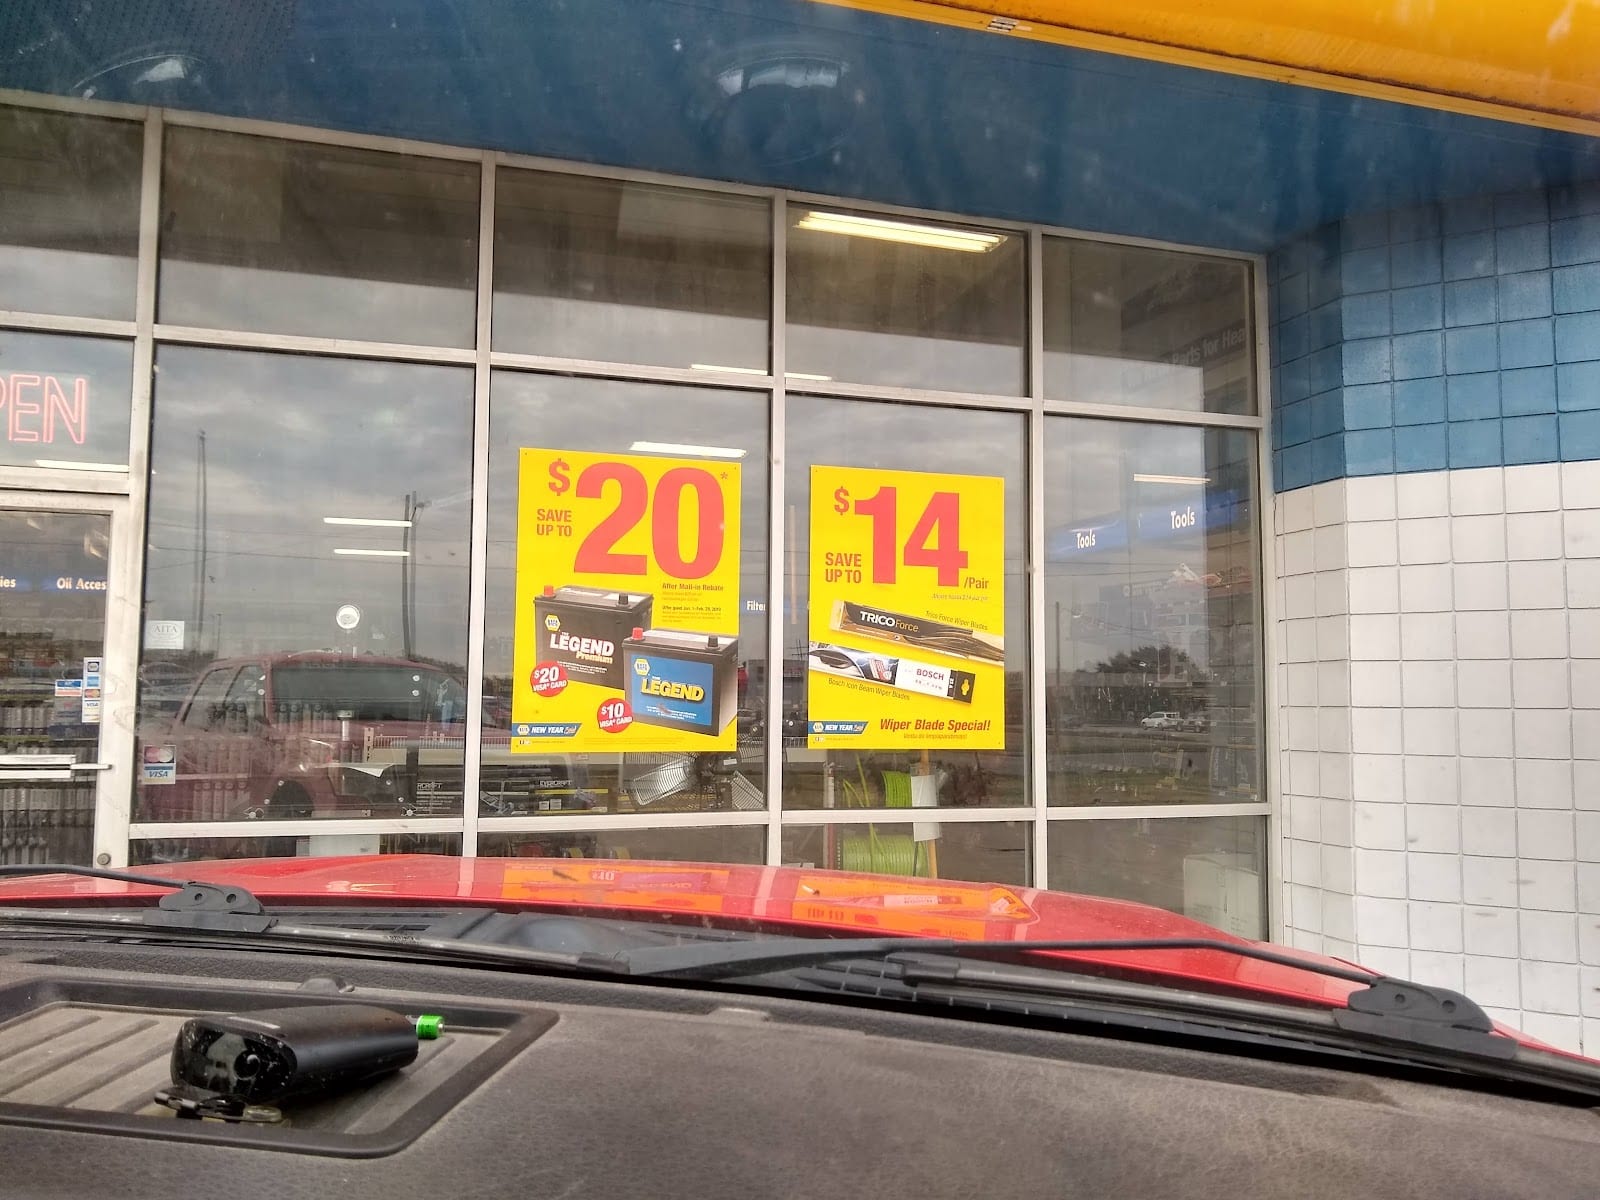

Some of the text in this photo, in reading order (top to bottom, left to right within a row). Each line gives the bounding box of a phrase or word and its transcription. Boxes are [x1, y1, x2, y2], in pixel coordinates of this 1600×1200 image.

[0, 373, 87, 444] EN
[536, 508, 572, 523] SAVE
[1171, 506, 1195, 529] Tools
[536, 523, 572, 537] UP TO
[834, 486, 968, 587] $14
[1077, 530, 1096, 549] Tools
[825, 552, 862, 567] SAVE
[56, 577, 72, 589] Oil
[825, 569, 862, 584] UP TO
[963, 577, 990, 589] /Pair
[860, 611, 896, 627] TRICO
[895, 620, 919, 633] Force
[550, 633, 615, 657] LEGEND
[576, 651, 613, 665] Premium
[534, 666, 560, 684] $20
[916, 668, 944, 681] BOSCH
[550, 680, 567, 689] CARD
[641, 678, 705, 702] LEGEND
[828, 678, 845, 687] Bosch
[859, 684, 875, 693] Beam
[875, 688, 891, 697] Wiper
[891, 691, 910, 700] Blades
[601, 702, 624, 720] $10
[531, 726, 547, 734] NEW
[547, 726, 564, 734] YEAR
[880, 718, 911, 733] Wiper
[915, 719, 945, 731] Blade
[948, 719, 991, 733] Special!
[148, 770, 169, 779] VISA
